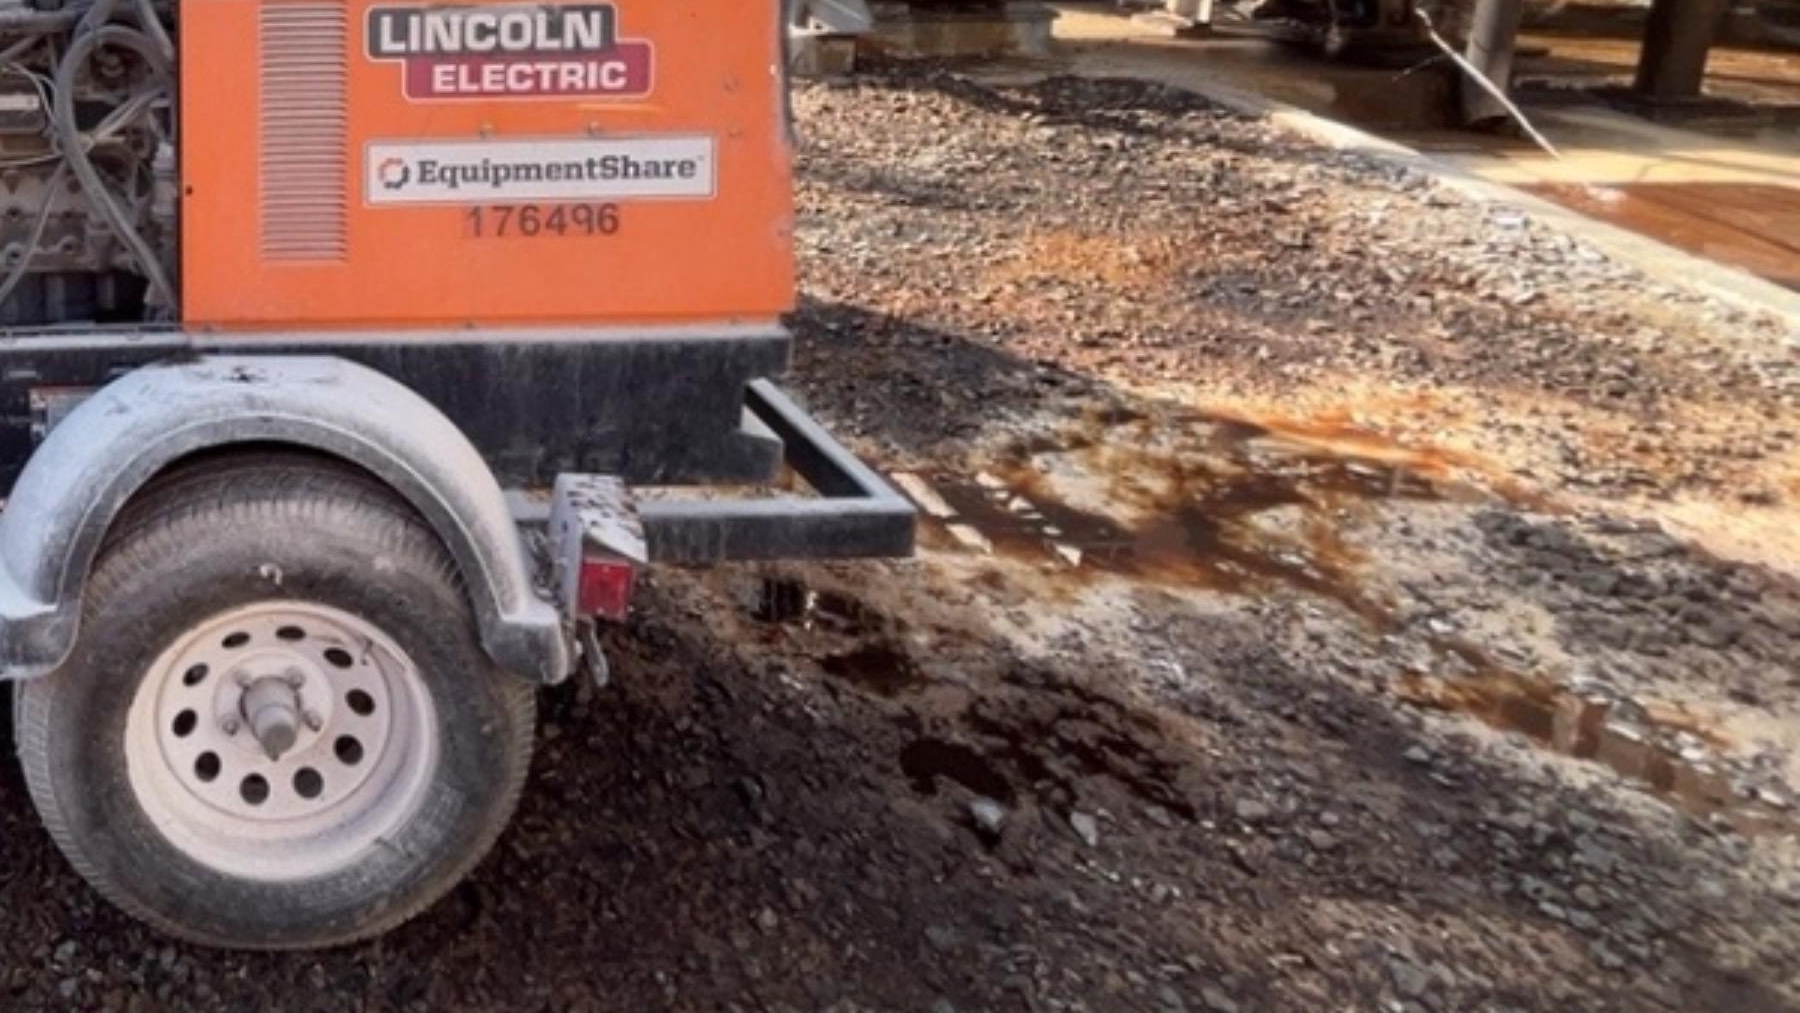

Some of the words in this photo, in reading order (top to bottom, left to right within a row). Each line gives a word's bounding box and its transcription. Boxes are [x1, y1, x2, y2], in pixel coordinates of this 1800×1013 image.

[380, 9, 602, 53] LINCOLN
[432, 60, 627, 93] ELECTRIC
[416, 154, 698, 189] EquipmentShare
[467, 202, 621, 238] 176496
